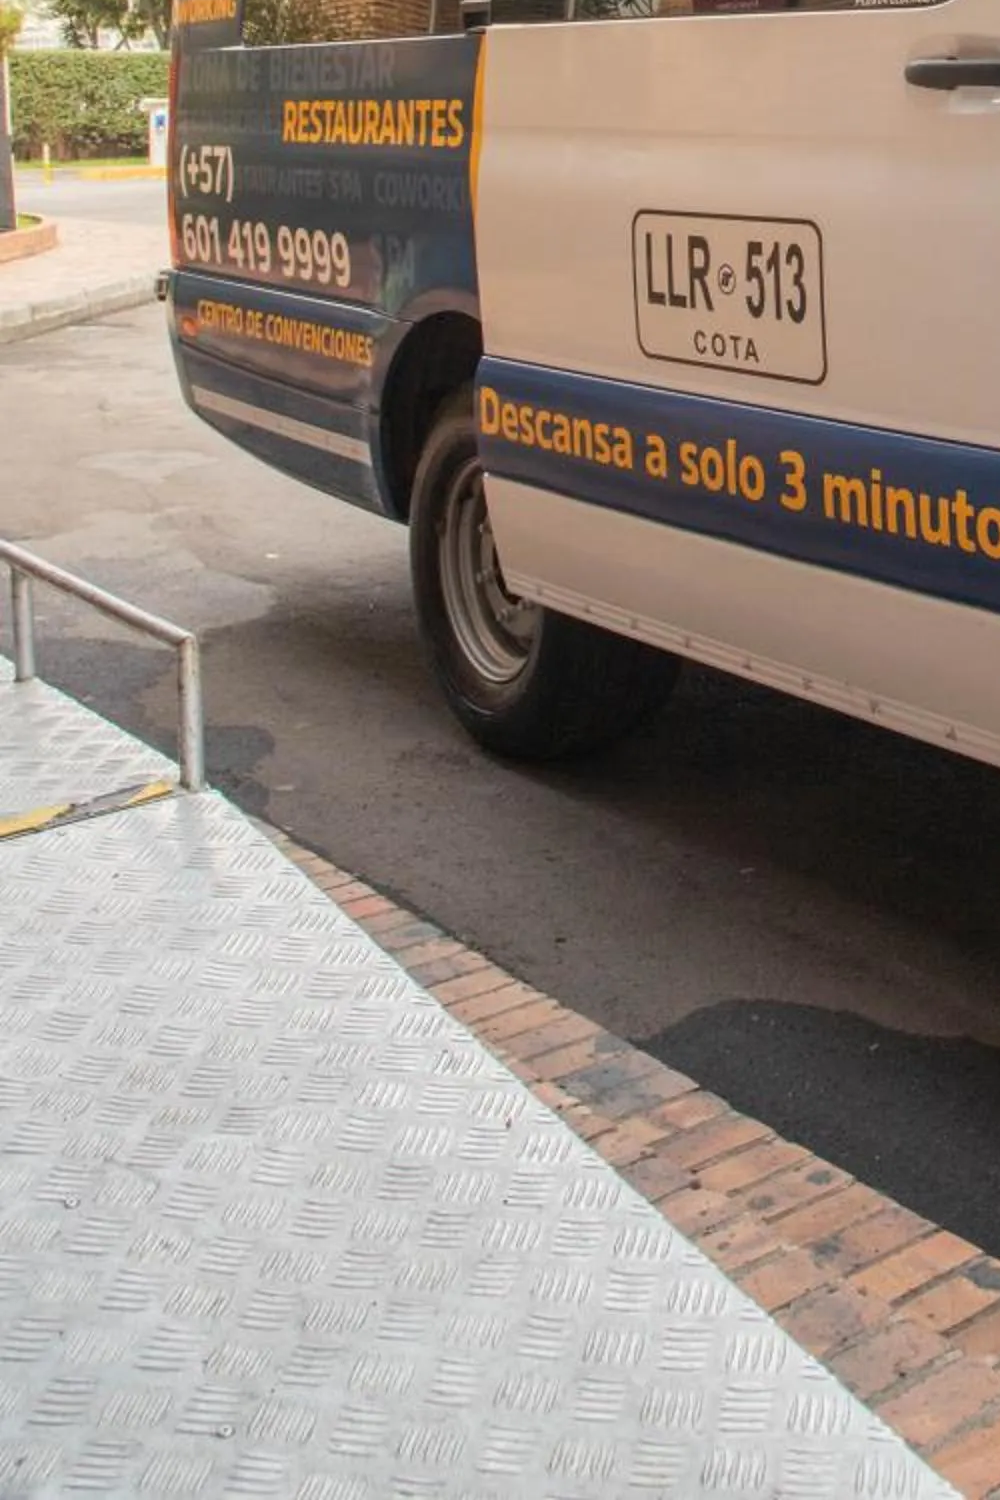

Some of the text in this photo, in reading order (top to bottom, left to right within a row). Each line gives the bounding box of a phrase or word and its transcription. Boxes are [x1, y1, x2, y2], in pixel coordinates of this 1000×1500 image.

[282, 99, 464, 148] RESTAURANTES
[179, 145, 235, 203] (+57)
[182, 213, 352, 289] 601 419 9999
[645, 231, 807, 324] LLR 513
[197, 299, 373, 368] CENTRO DE CONVENCIONES
[693, 330, 760, 364] COTA
[479, 386, 633, 469] Descansa
[645, 434, 668, 479] a
[681, 439, 765, 502] solo
[780, 450, 807, 512] 3
